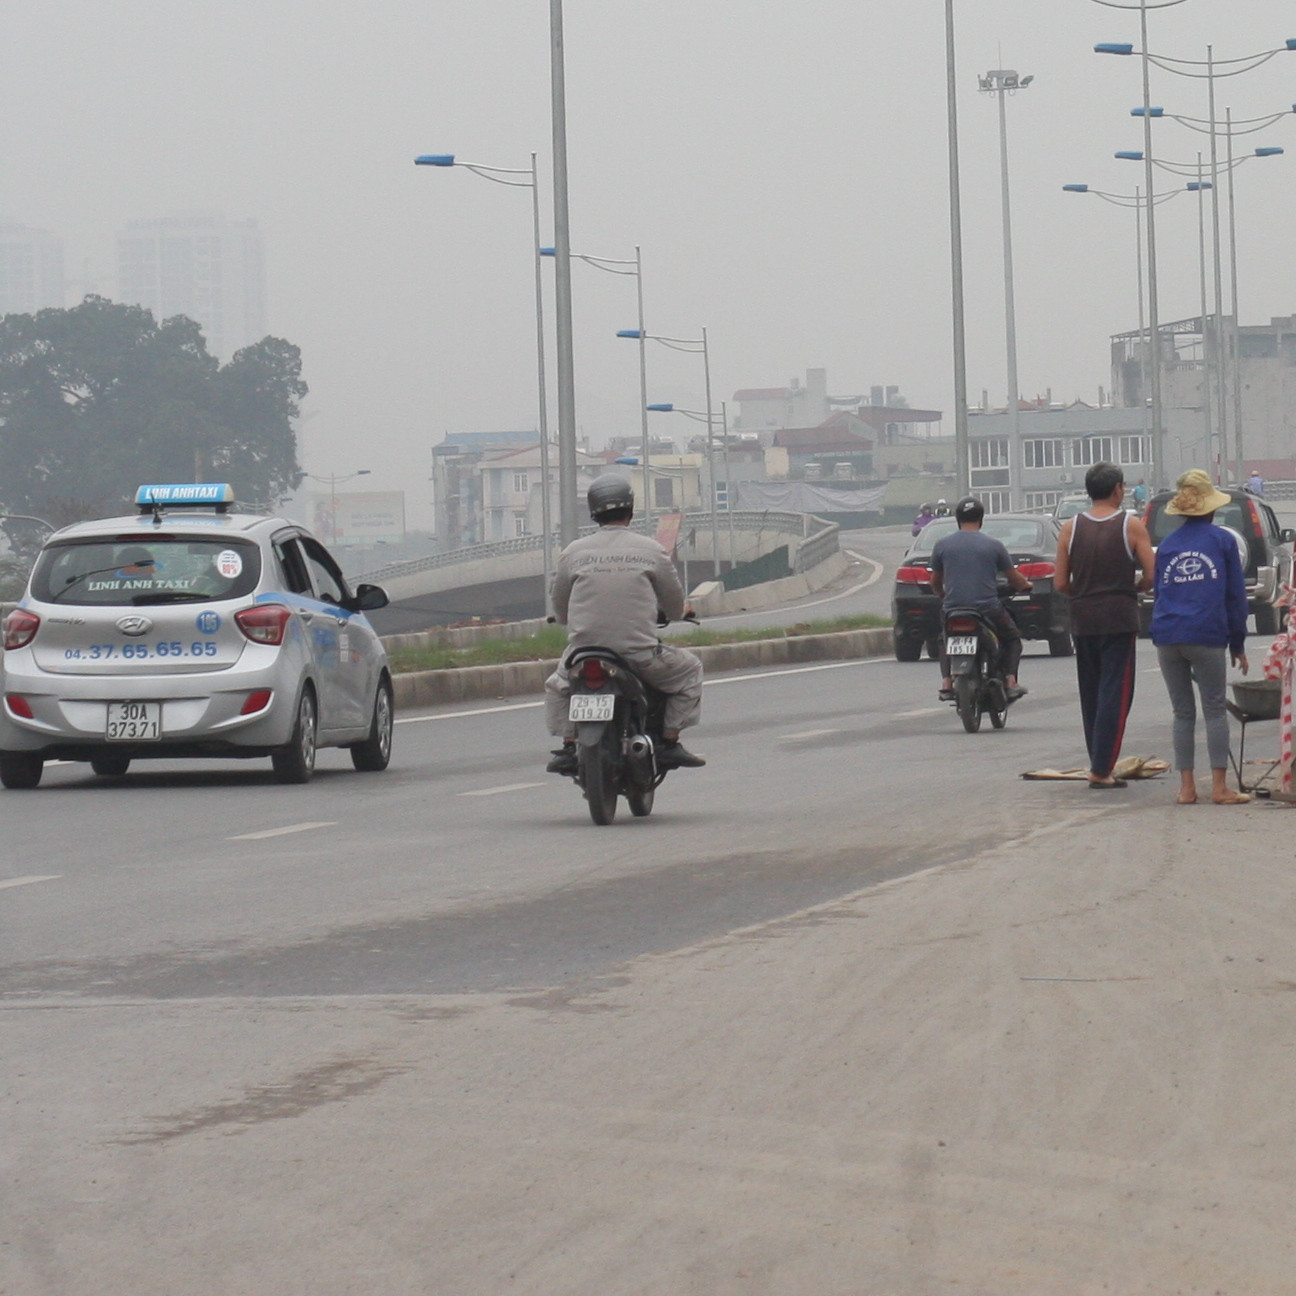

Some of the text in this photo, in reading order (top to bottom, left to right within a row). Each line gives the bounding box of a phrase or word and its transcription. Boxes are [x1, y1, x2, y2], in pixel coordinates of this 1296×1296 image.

[87, 579, 190, 591] LINH ANH TAXI
[120, 704, 148, 720] 30A
